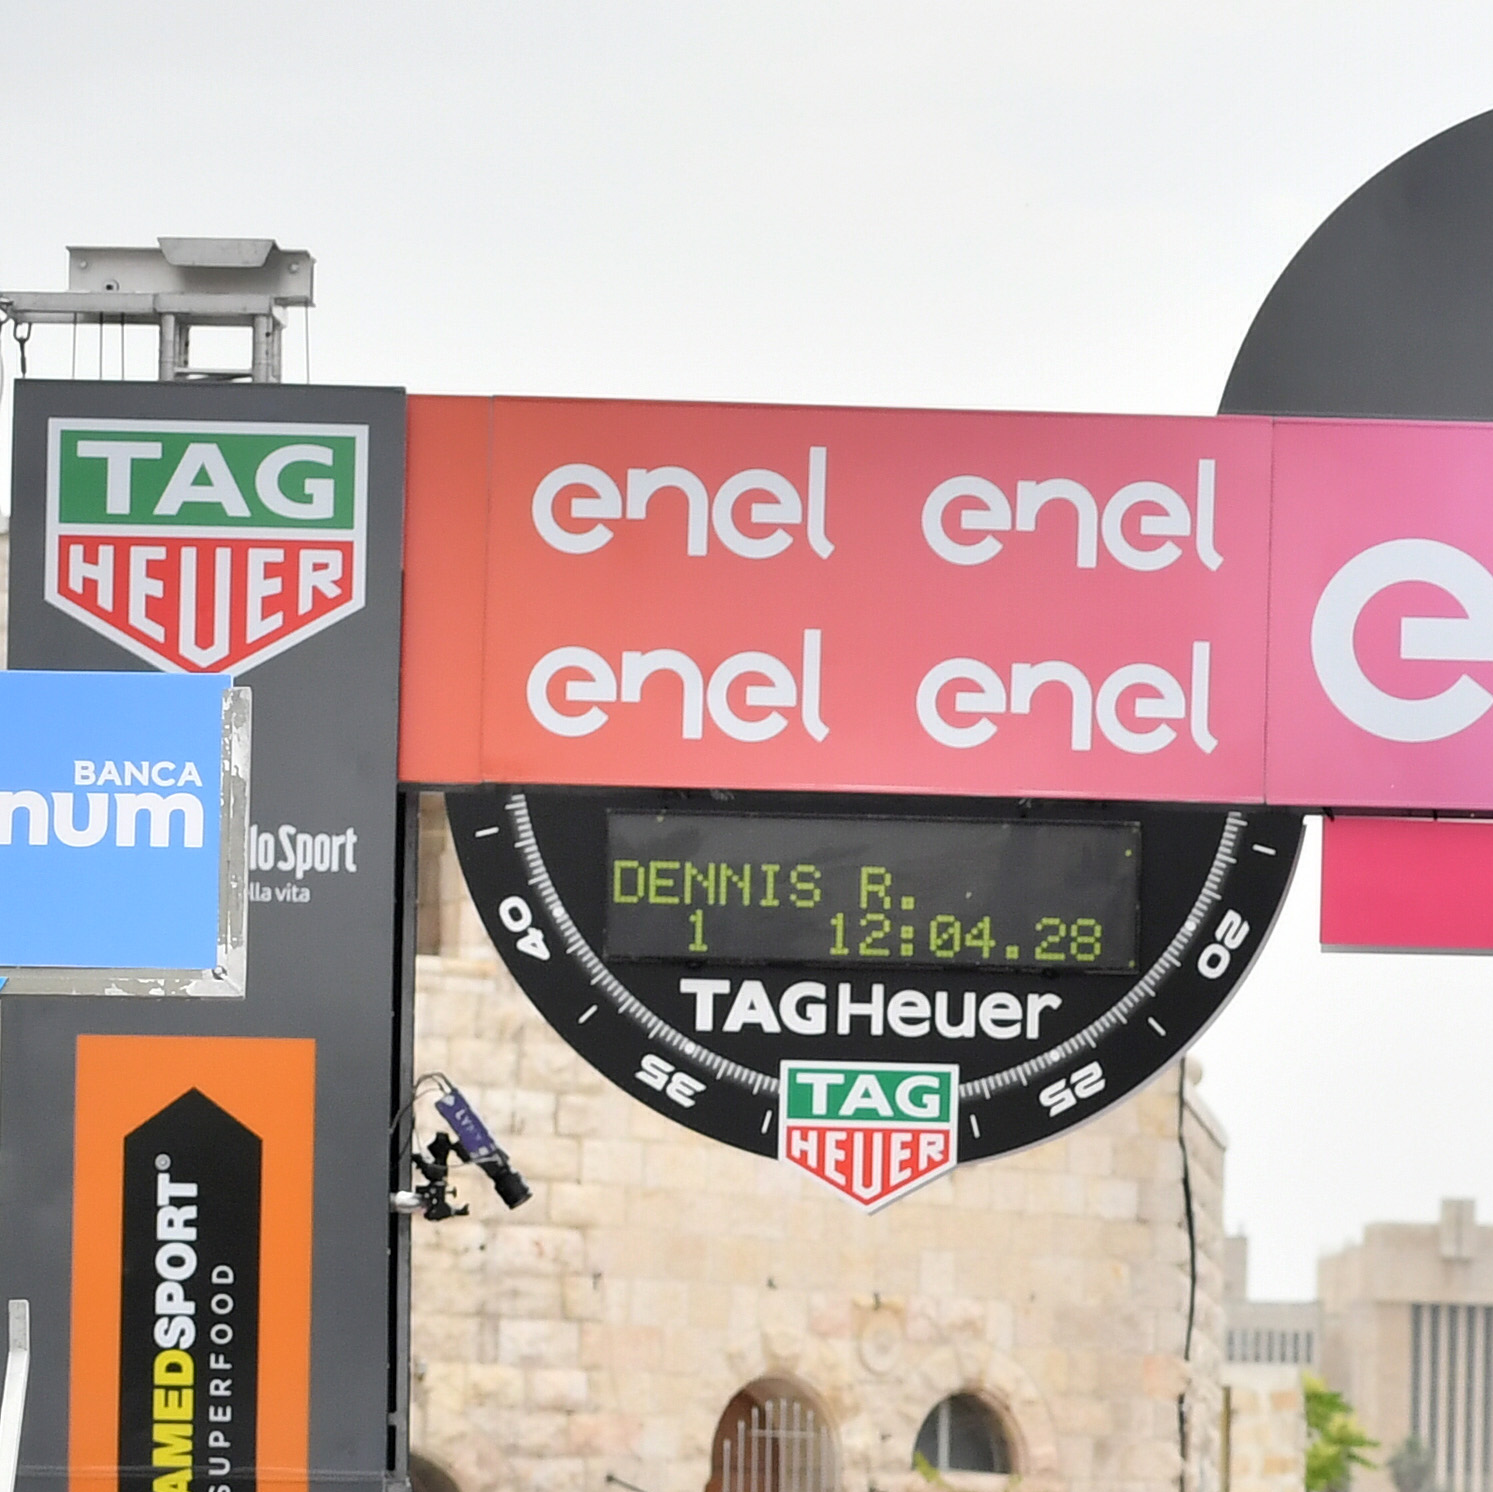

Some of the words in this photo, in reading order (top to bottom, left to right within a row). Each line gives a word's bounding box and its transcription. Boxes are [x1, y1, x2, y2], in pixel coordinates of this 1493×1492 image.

[76, 441, 335, 520] TAG
[532, 446, 835, 560] enel
[921, 458, 1224, 572] enel
[69, 544, 342, 659] HEUER
[527, 629, 830, 743] enel
[915, 640, 1218, 754] enel
[74, 760, 203, 788] BANCA
[277, 824, 358, 880] Sport
[612, 860, 822, 906] DENNIS
[860, 866, 917, 911] R.
[276, 882, 310, 902] vita
[498, 894, 551, 962] 40
[688, 910, 708, 953] 1
[829, 912, 1103, 962] 12:04.28
[1196, 910, 1251, 980] 20
[636, 1053, 707, 1109] 35
[796, 1072, 943, 1118] TAG
[1039, 1060, 1107, 1120] 25
[789, 1130, 946, 1198] HEUER
